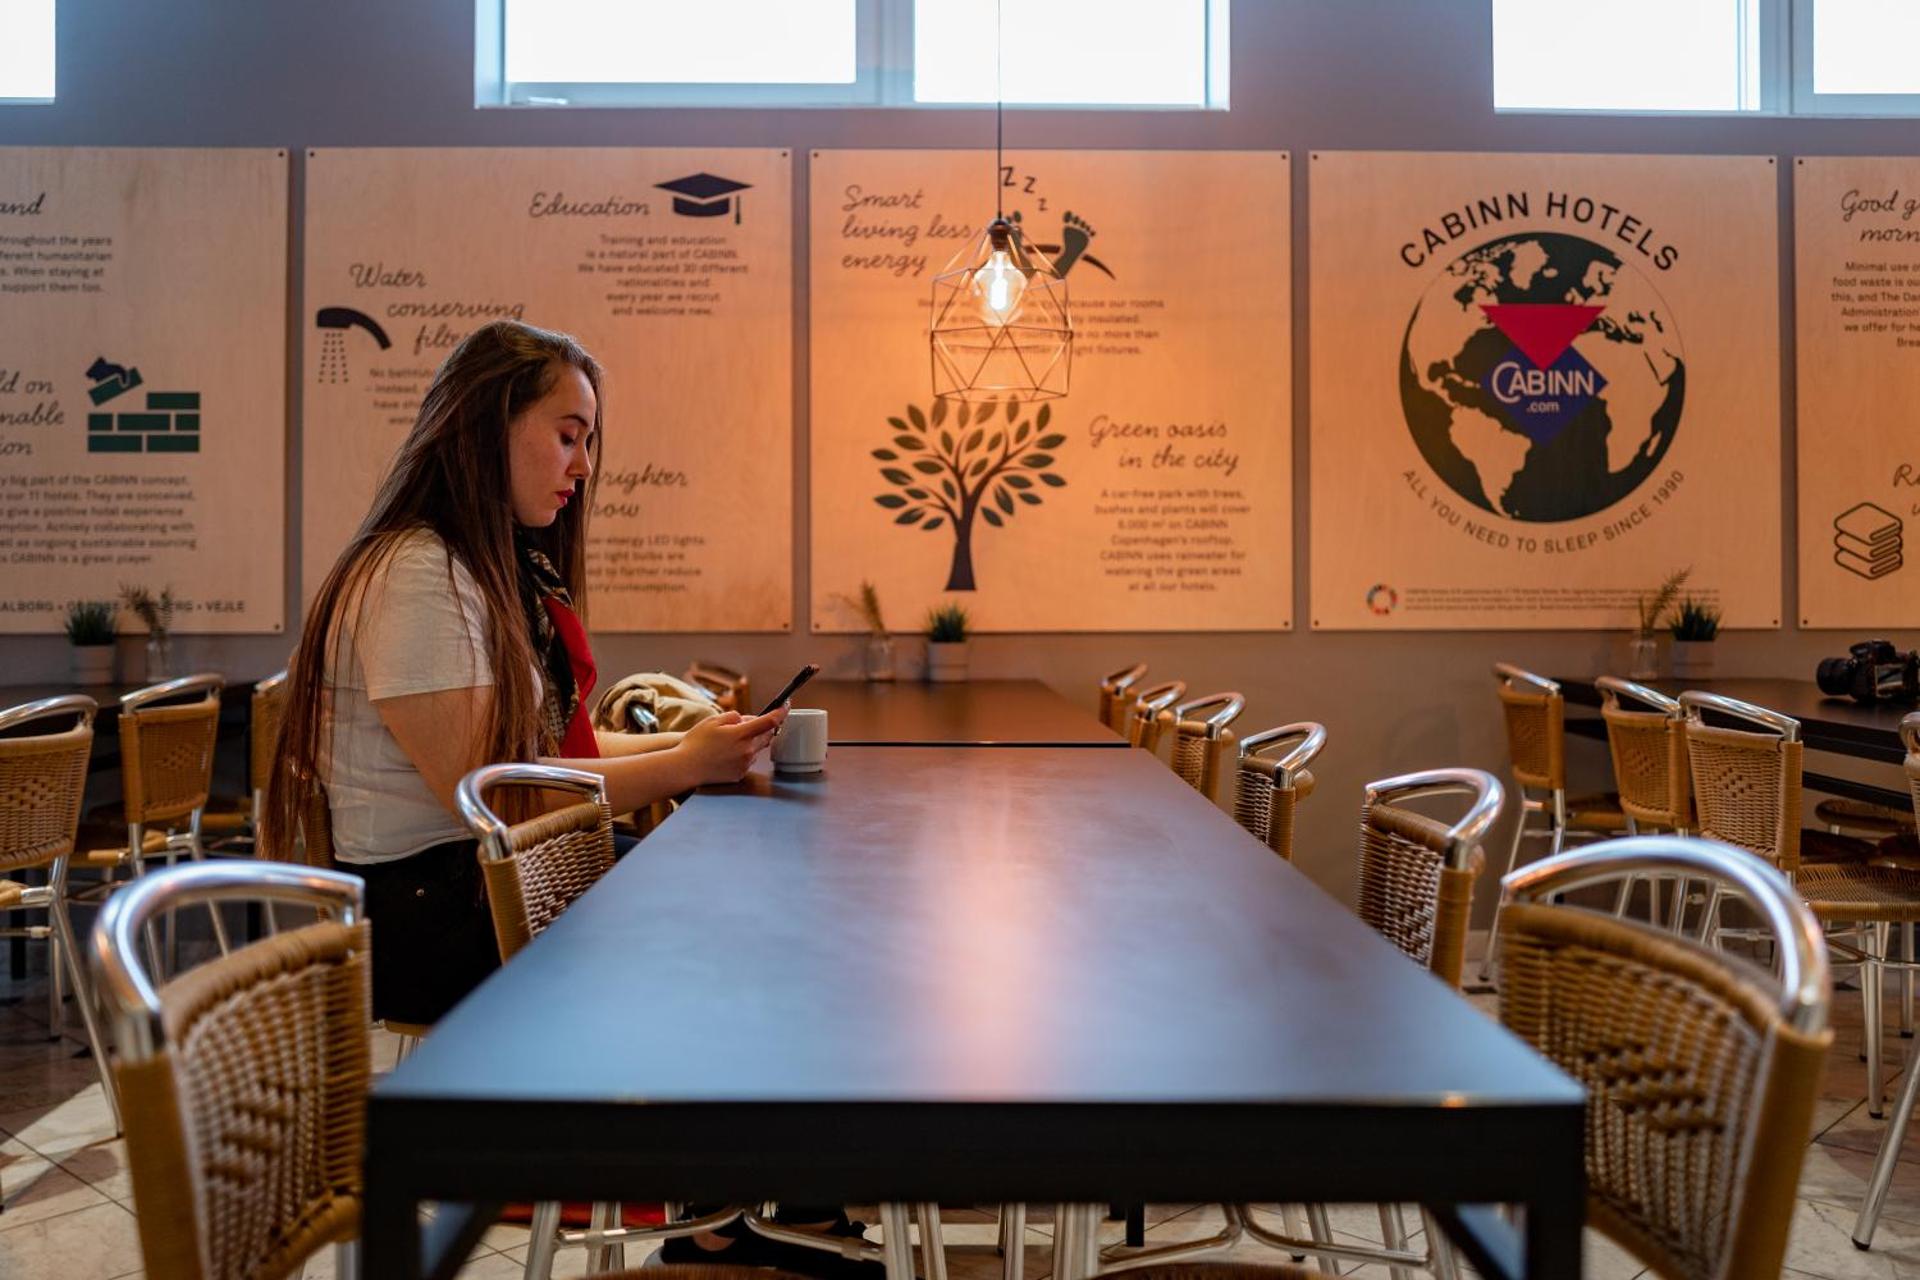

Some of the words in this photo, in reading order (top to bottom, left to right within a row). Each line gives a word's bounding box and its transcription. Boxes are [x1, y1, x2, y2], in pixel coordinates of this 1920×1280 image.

[528, 192, 650, 218] Education
[842, 184, 924, 212] Smart
[1841, 189, 1899, 222] Good
[842, 214, 919, 248] living
[926, 213, 971, 240] less
[1400, 192, 1531, 268] CABINN
[1545, 191, 1680, 272] HOTELS
[349, 261, 427, 289] Water
[842, 254, 928, 278] energy
[1845, 262, 1887, 272] Minimal
[1889, 263, 1909, 272] use
[1832, 277, 1857, 287] food
[1859, 277, 1891, 287] waste
[1894, 277, 1904, 287] is
[1857, 292, 1878, 302] and
[1880, 291, 1900, 302] The
[387, 299, 525, 323] conserving
[1862, 321, 1888, 332] offer
[26, 381, 54, 394] on
[1491, 361, 1595, 403] CABINN
[1525, 401, 1560, 414] .com
[1089, 415, 1159, 448] Green
[1167, 419, 1228, 439] oasis
[1119, 448, 1143, 468] in
[1152, 443, 1187, 468] the
[1194, 447, 1240, 477] city
[601, 463, 688, 495] righter
[1402, 467, 1426, 500] ALL
[1430, 496, 1462, 527] YOU
[1463, 521, 1510, 549] NEED
[1516, 537, 1537, 554] TO
[1543, 533, 1599, 555] SLEEP
[1602, 506, 1653, 542] SINCE
[1652, 469, 1686, 506] 1990
[205, 600, 246, 613] VEJLE
